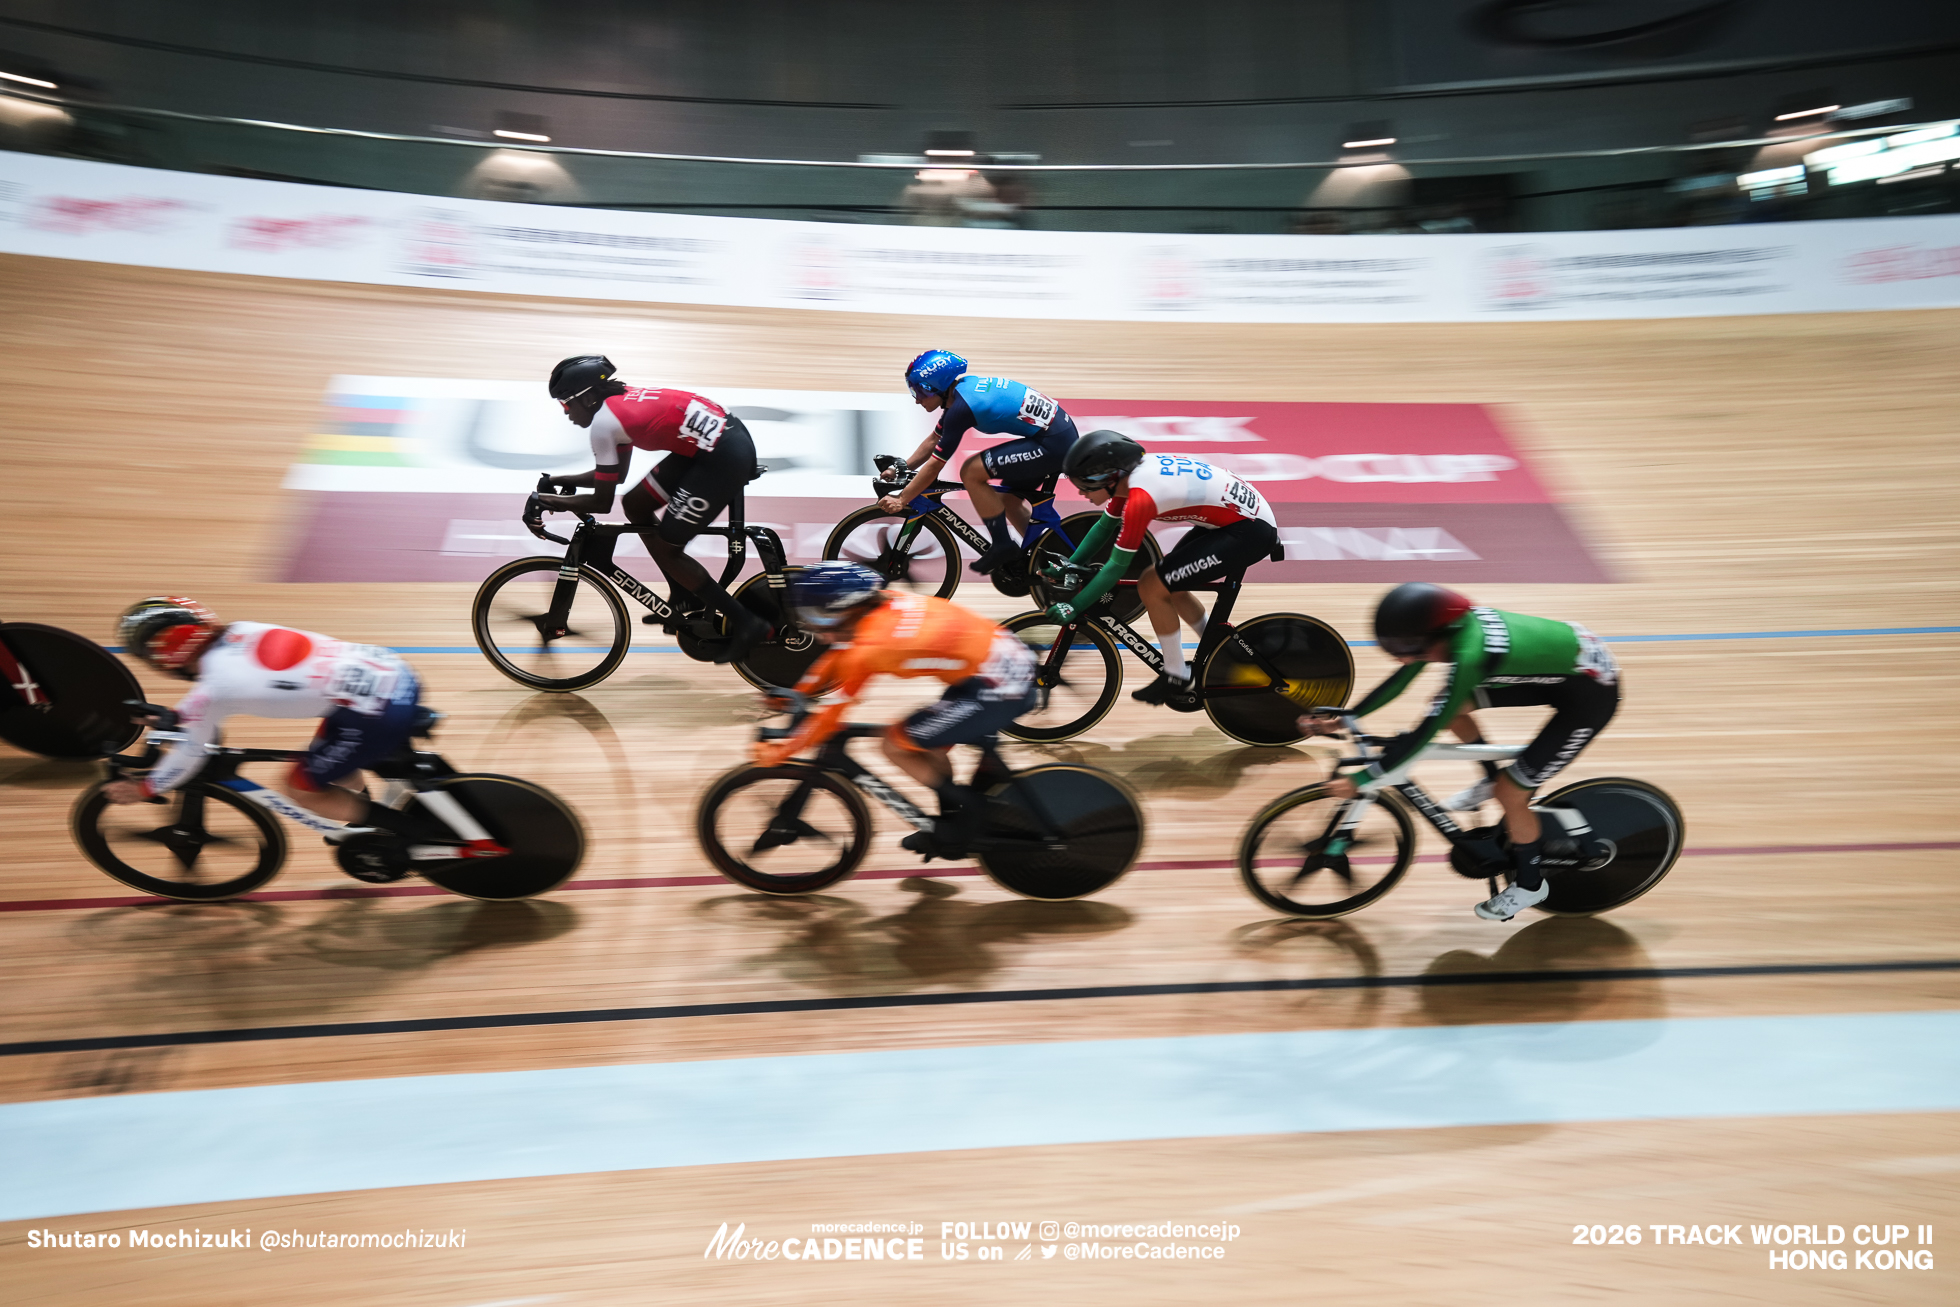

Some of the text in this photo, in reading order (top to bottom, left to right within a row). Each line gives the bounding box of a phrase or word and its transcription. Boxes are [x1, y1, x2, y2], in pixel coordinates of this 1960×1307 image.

[918, 355, 952, 378] RUDY
[686, 410, 719, 442] 442
[997, 448, 1044, 466] CASTELLI
[1192, 458, 1213, 481] GA
[1229, 481, 1256, 510] 438
[674, 496, 710, 525] TTO
[1155, 514, 1208, 523] PORTUGAL
[937, 507, 987, 553] PINAREL
[1164, 553, 1223, 586] PORTUGAL
[609, 569, 673, 619] SPMND
[1099, 615, 1161, 665] ARGON
